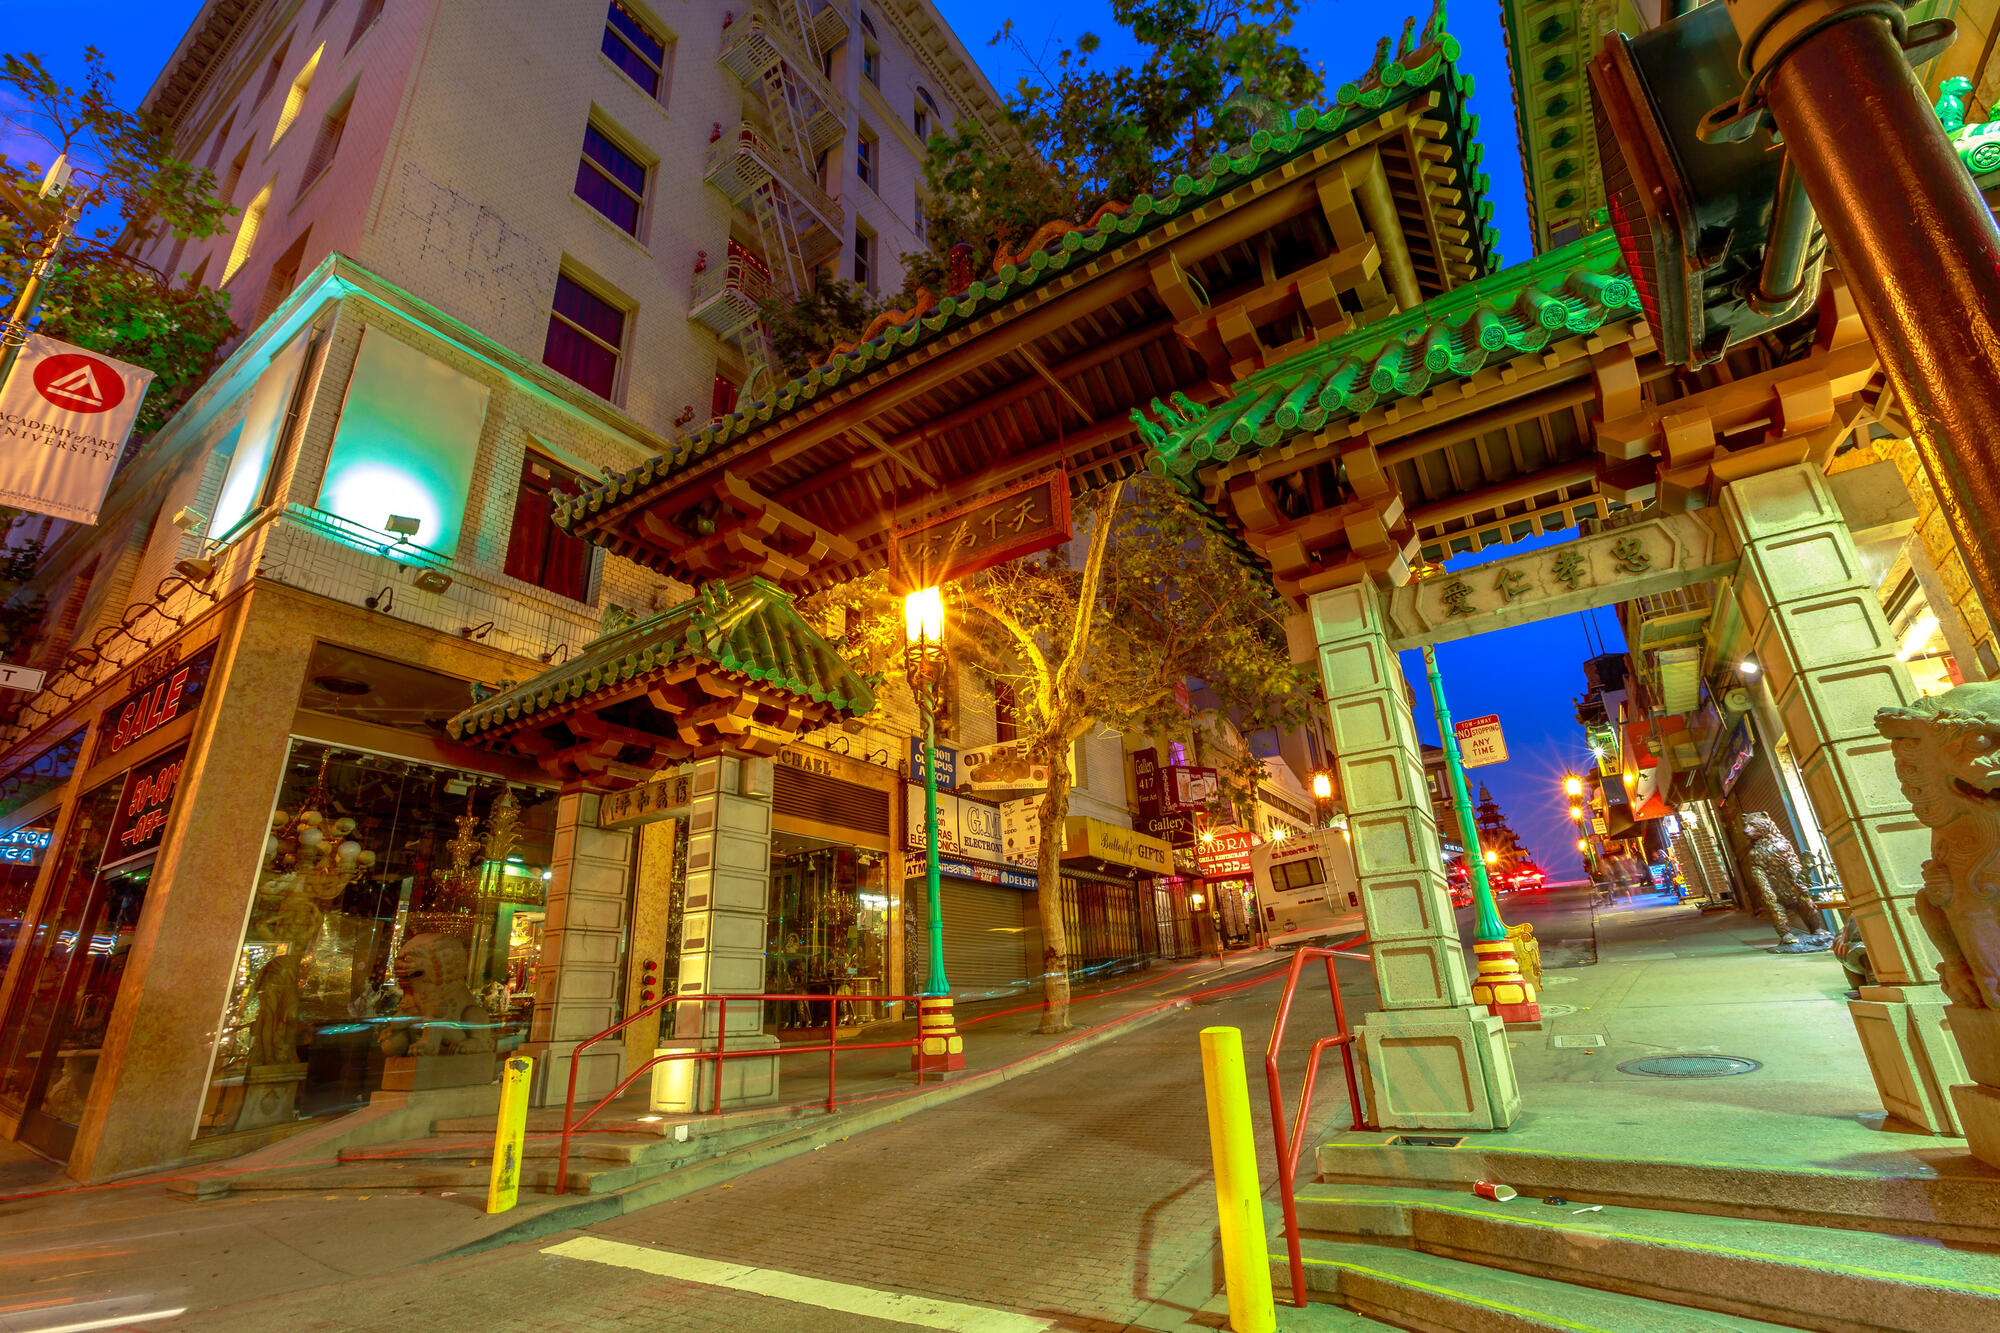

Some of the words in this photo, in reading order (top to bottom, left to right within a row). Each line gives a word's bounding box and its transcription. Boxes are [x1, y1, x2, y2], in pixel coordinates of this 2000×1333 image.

[0, 424, 115, 463] NIVERSITY
[75, 434, 90, 443] of
[88, 437, 118, 450] ART
[111, 666, 190, 753] SALE
[1461, 717, 1492, 728] TOW-AWAY
[1457, 728, 1471, 739] NO
[1471, 724, 1499, 736] STOPPING
[1472, 737, 1490, 748] ANY
[1472, 745, 1495, 756] TIME
[918, 742, 951, 762] Cnon
[915, 754, 953, 773] OLPUS
[1136, 758, 1154, 777] Gallery
[918, 766, 950, 784] Non
[1138, 778, 1154, 789] 417
[132, 808, 162, 845] OFF
[1148, 816, 1185, 832] Gallery
[916, 824, 953, 841] CARAS
[1161, 830, 1174, 841] 417
[910, 834, 959, 853] ELECONICS
[1100, 832, 1133, 861] Butterfly
[1138, 844, 1166, 864] GIFTS
[1197, 837, 1248, 855] SABRA
[906, 862, 926, 876] ATM
[938, 861, 972, 876] msonite
[974, 865, 999, 876] LUGGAGE
[980, 873, 993, 883] SALE
[1008, 874, 1036, 888] DELSEY
